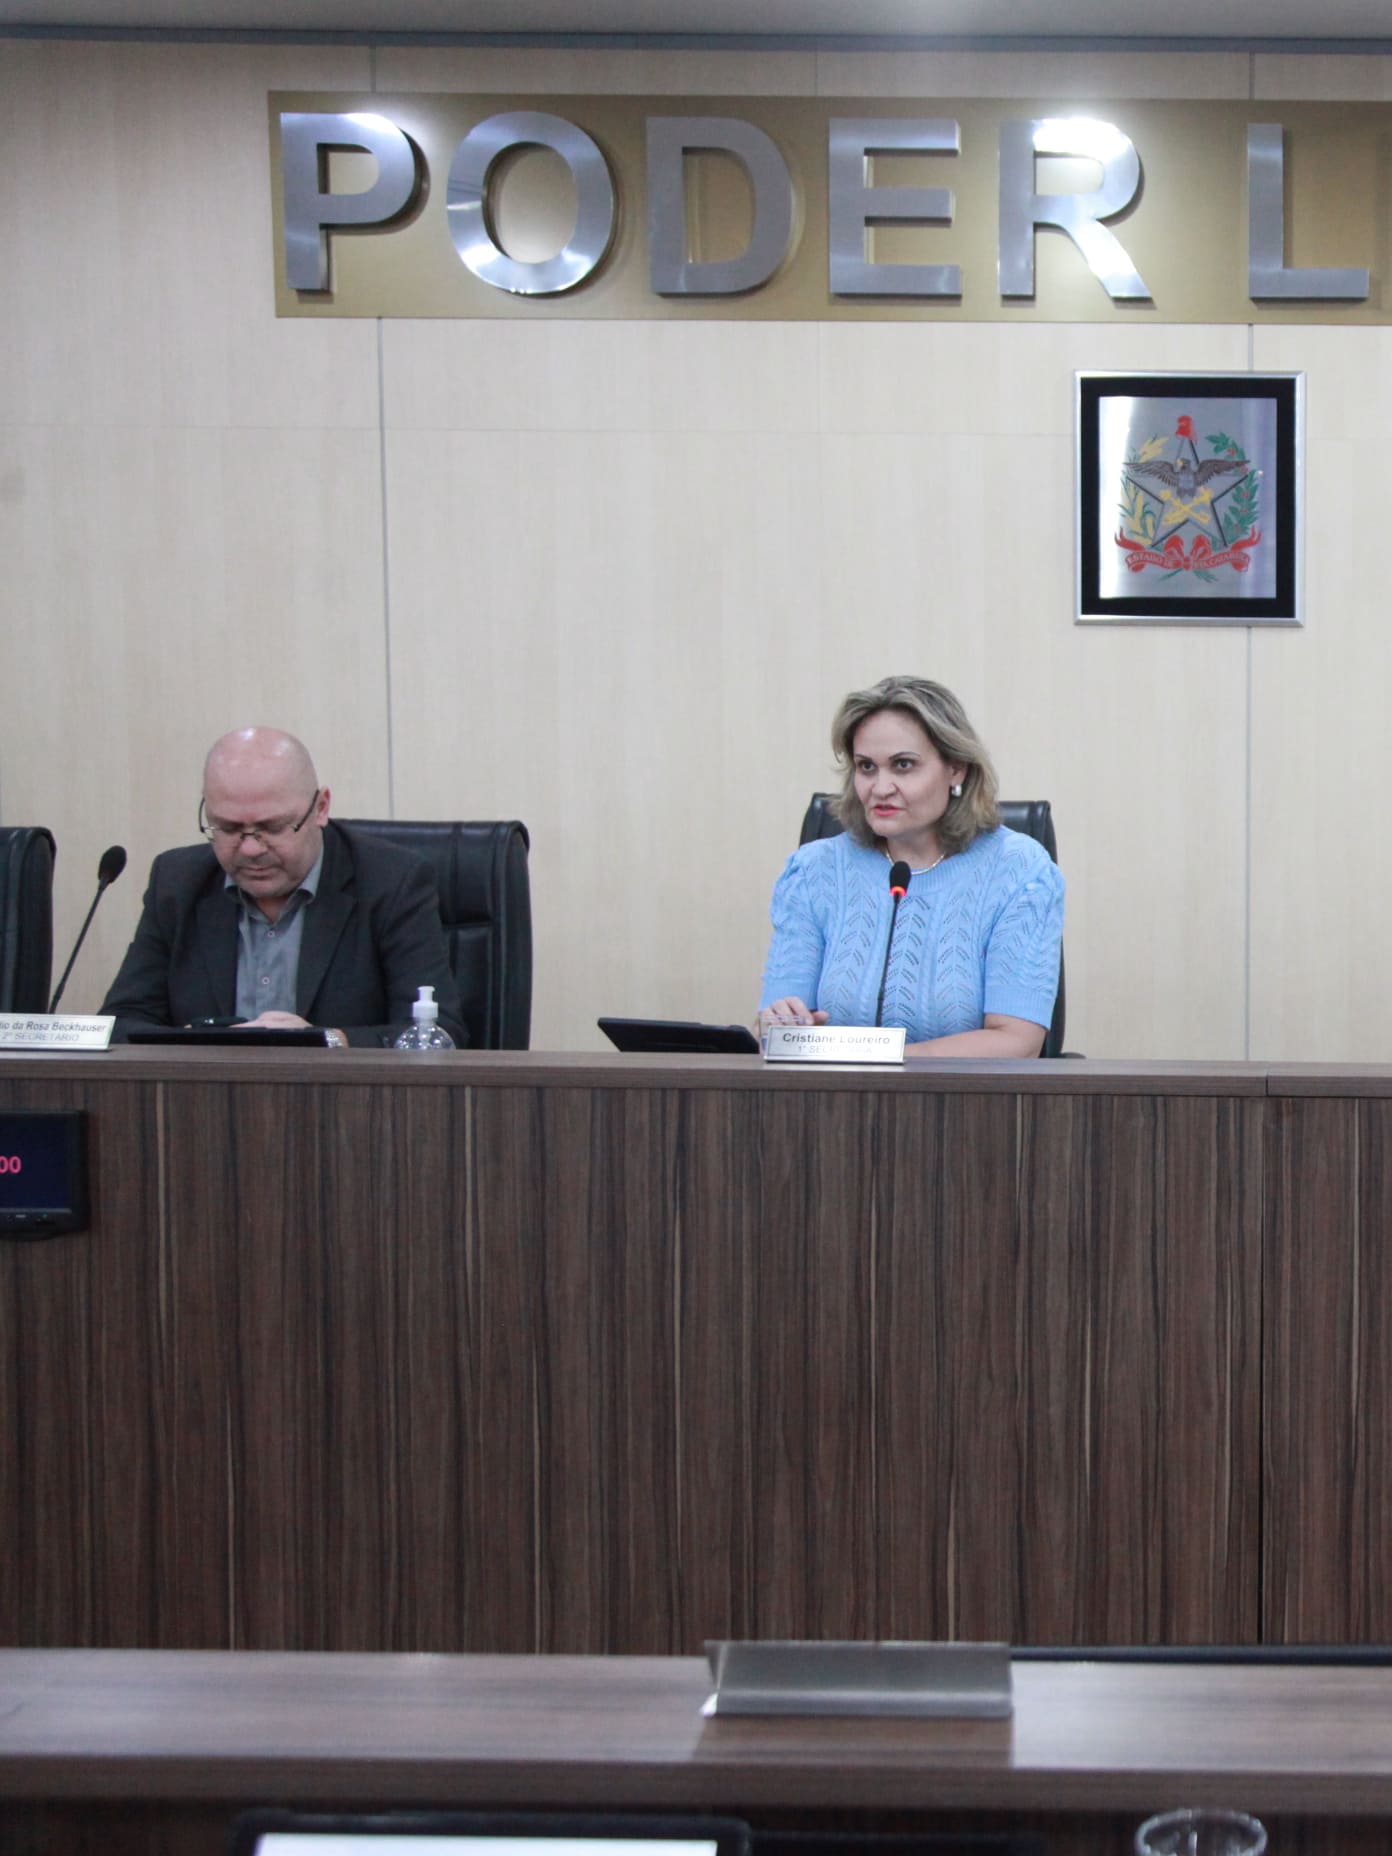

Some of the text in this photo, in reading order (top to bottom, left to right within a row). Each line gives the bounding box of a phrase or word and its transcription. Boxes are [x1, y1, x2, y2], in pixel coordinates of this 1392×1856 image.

[280, 110, 1153, 302] PODER
[26, 1020, 50, 1031] Rosa
[782, 1032, 891, 1045] Cristiane Loureiro
